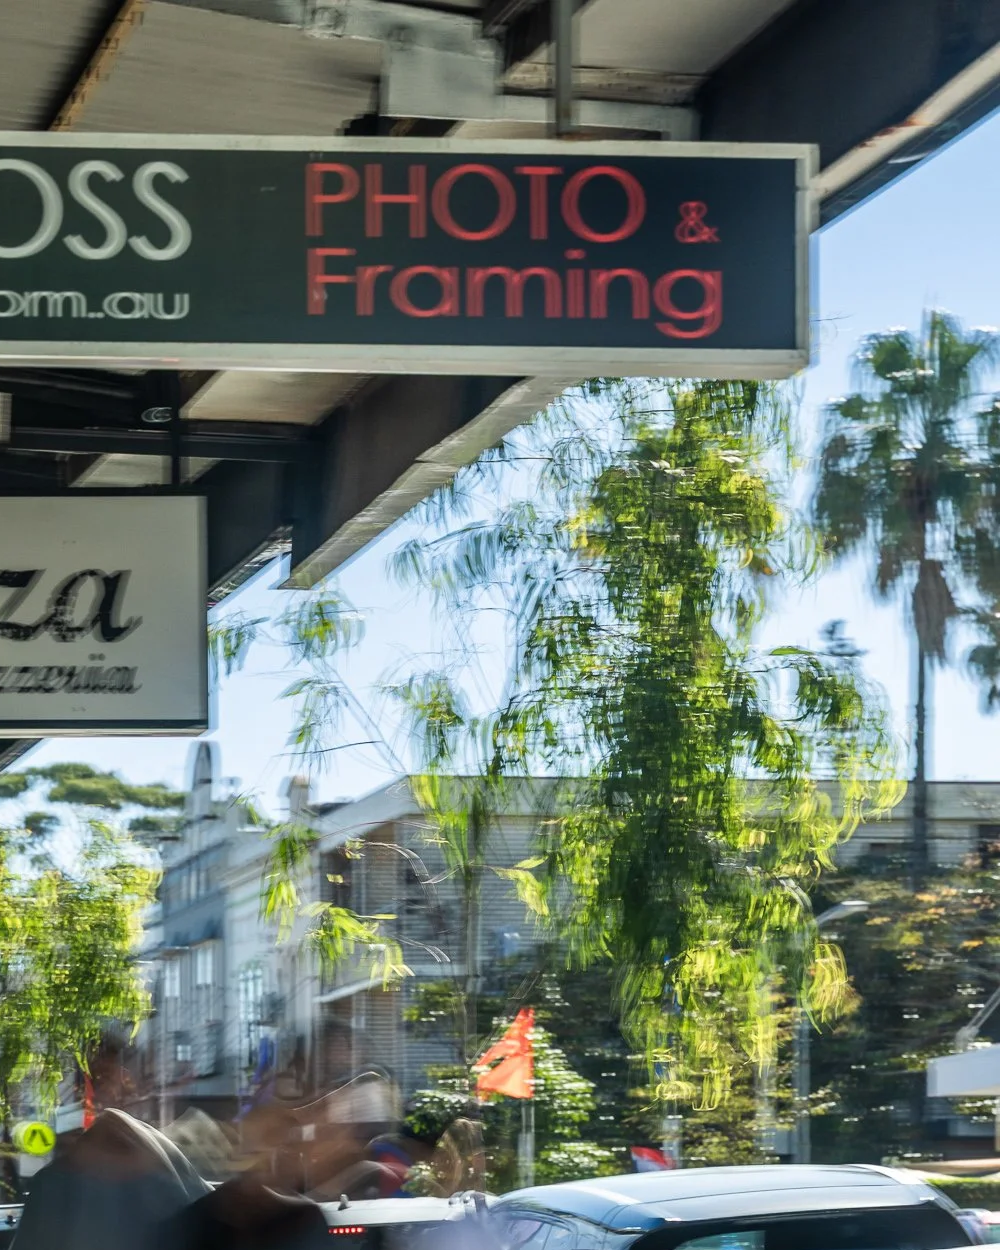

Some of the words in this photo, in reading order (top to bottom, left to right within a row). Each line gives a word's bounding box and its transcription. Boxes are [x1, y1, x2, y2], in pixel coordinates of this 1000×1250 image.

[304, 161, 647, 244] PHOTO
[674, 200, 719, 244] &
[306, 247, 723, 338] Framing
